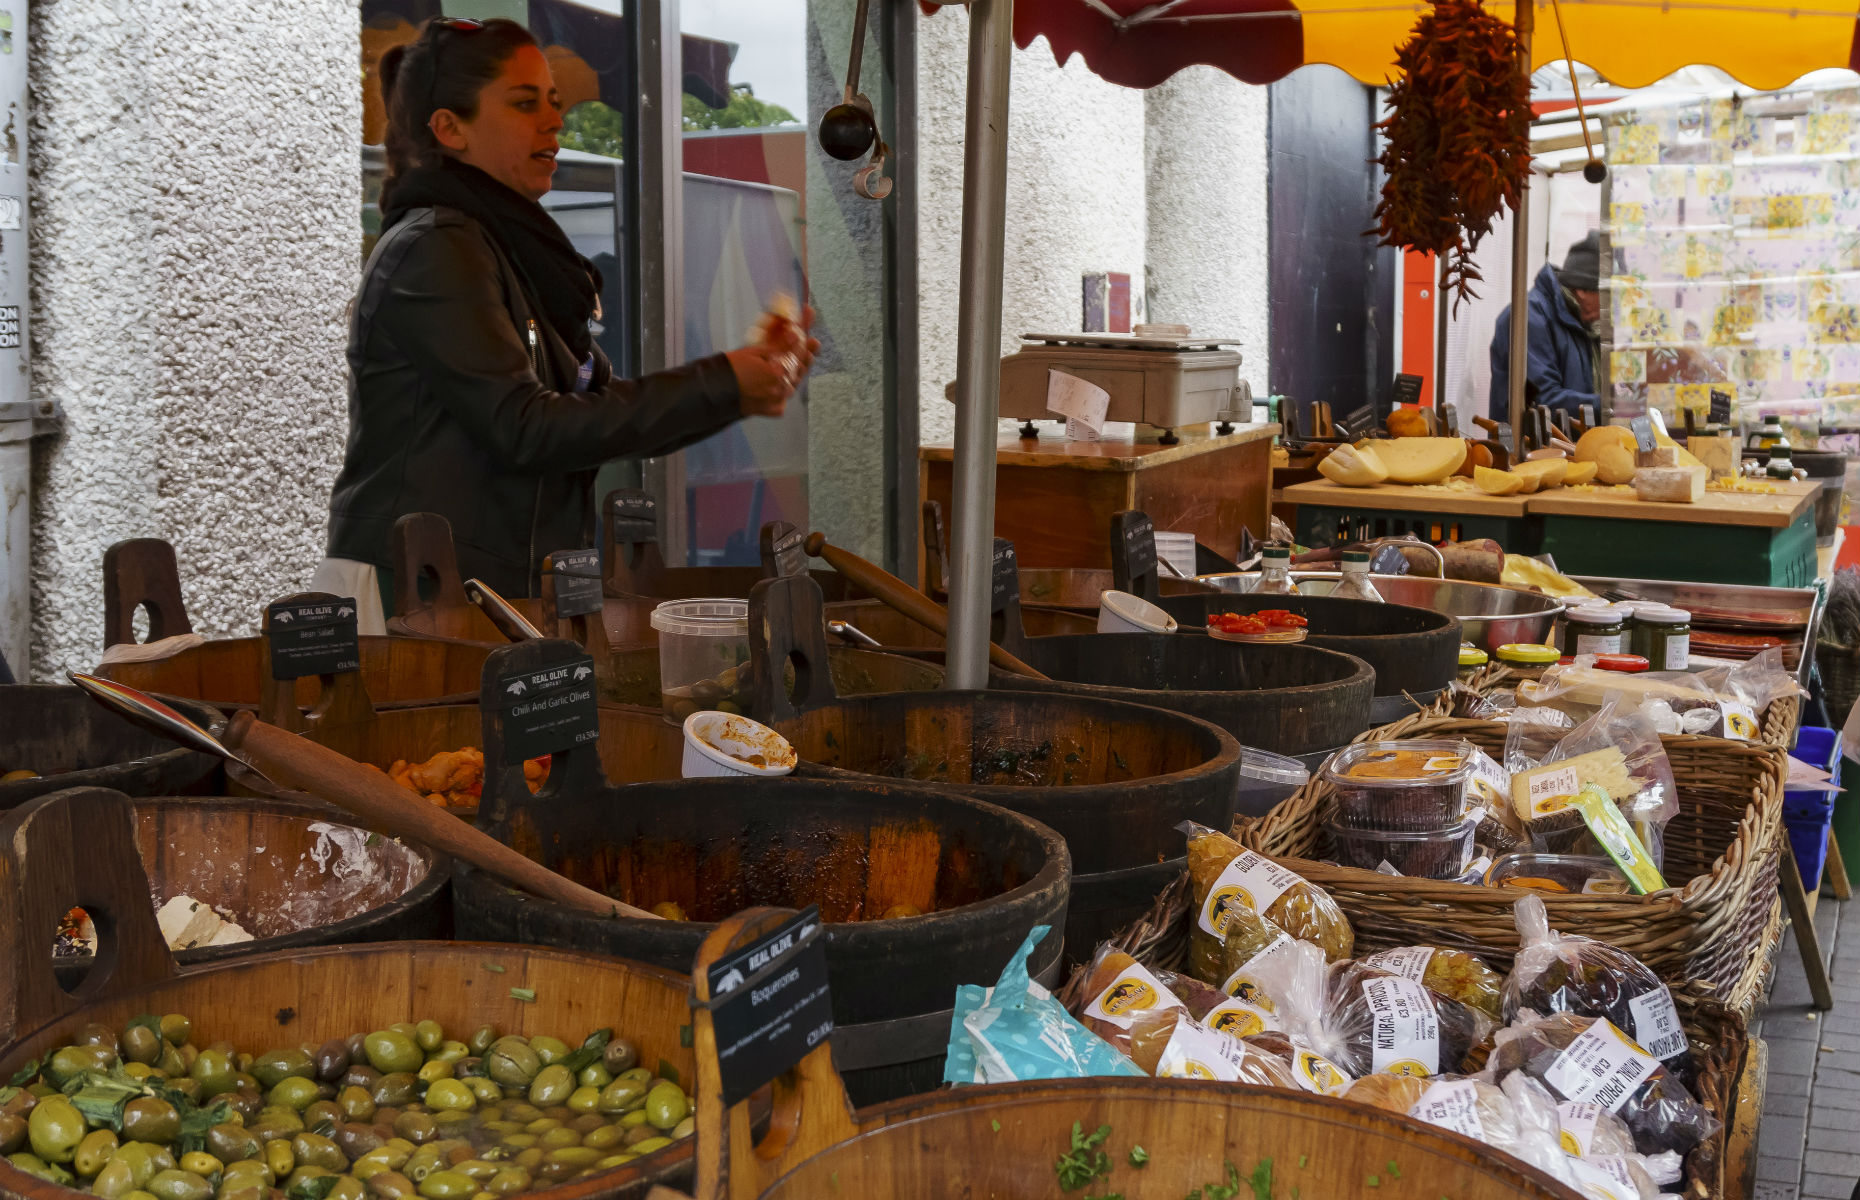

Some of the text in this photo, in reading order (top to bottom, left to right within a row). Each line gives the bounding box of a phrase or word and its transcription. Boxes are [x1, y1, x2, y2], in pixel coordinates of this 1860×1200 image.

[298, 606, 332, 616] REAL OLIVE
[531, 669, 568, 684] REAL OLIVE
[532, 700, 547, 712] And
[548, 696, 569, 708] Garlic
[569, 690, 590, 703] Olives
[748, 934, 793, 971] REAL OLIVE
[751, 967, 800, 1007] Boquerones
[1109, 984, 1146, 1012] REAL OLIVE
[1377, 1012, 1395, 1050] NATURAL
[1616, 1056, 1645, 1083] NATURAL
